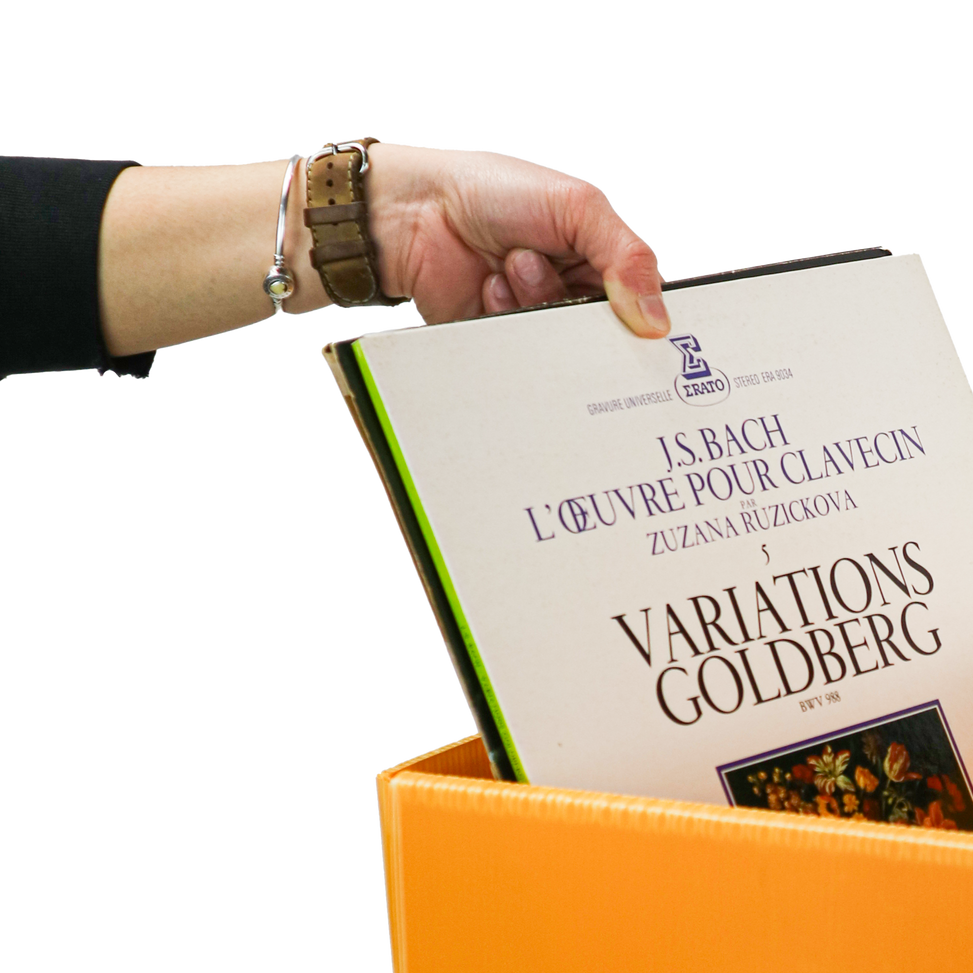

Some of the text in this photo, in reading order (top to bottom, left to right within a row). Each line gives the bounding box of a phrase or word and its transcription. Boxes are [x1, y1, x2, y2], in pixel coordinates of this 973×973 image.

[733, 368, 794, 388] STEREO ERA 9034
[587, 389, 673, 415] GRAVURE UNIVERSELLE
[685, 458, 780, 506] POUR
[780, 426, 926, 485] CLAVECIN
[740, 498, 757, 510] PAR
[646, 489, 859, 556] ZUZANA RUZICKOVA
[760, 544, 770, 566] 5
[610, 541, 935, 668] VARIATIONS
[656, 601, 942, 727] GOLDBERG
[799, 691, 841, 713] BWV 988
